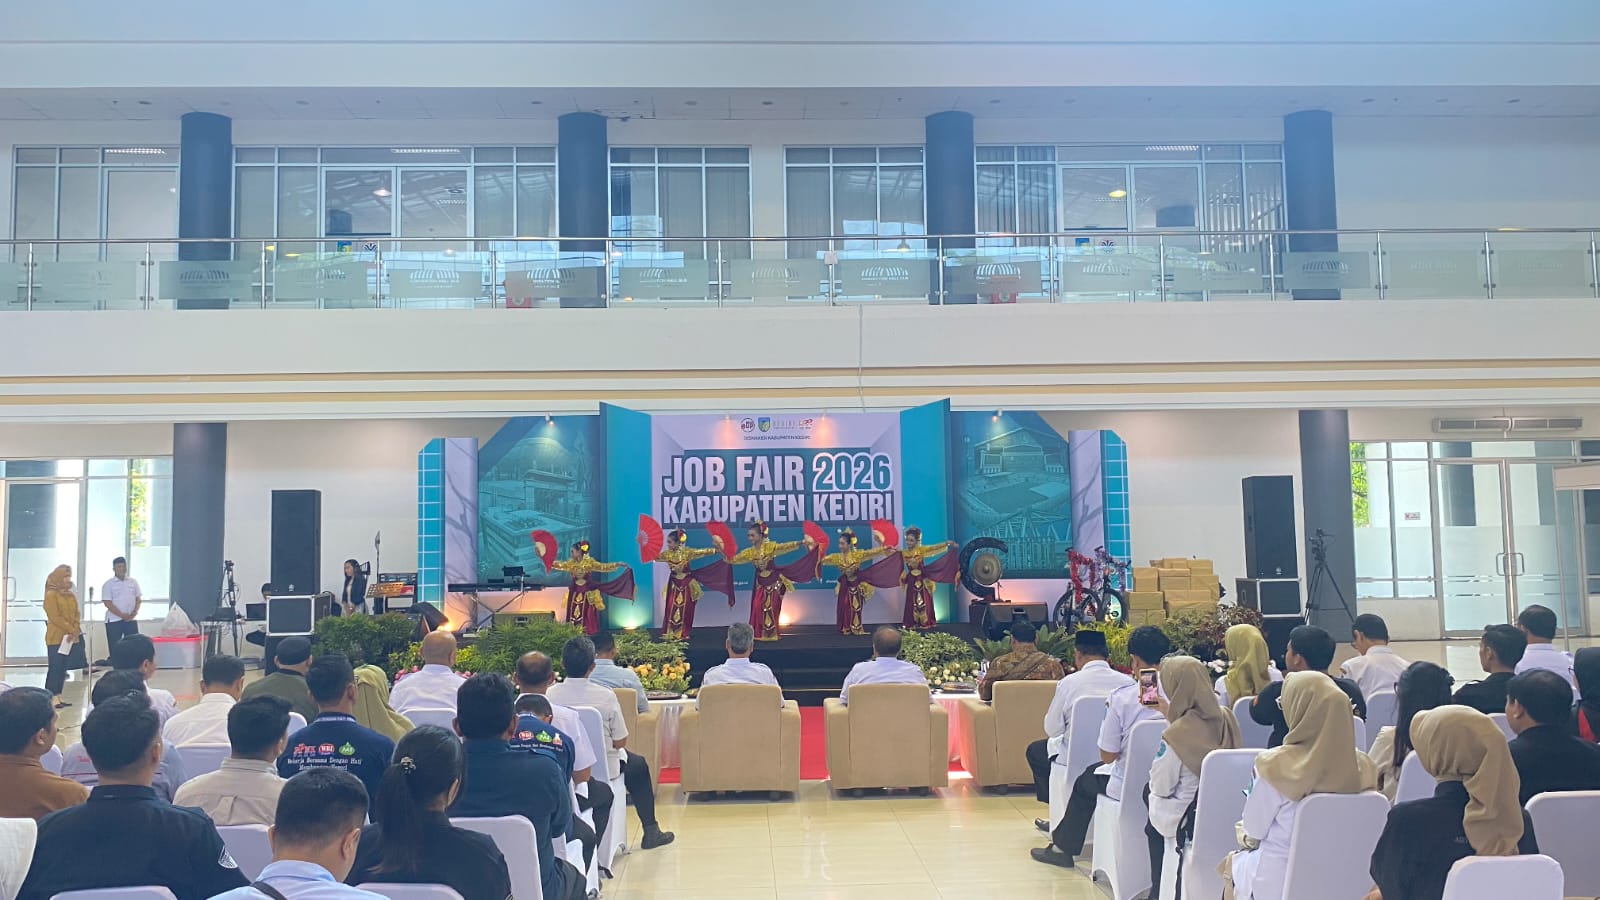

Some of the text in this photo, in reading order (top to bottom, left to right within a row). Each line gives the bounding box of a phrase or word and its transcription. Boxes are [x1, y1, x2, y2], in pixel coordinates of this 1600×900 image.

[663, 452, 892, 493] JOB FAIR 2026
[663, 492, 892, 524] KABUPATEN KEDIRI
